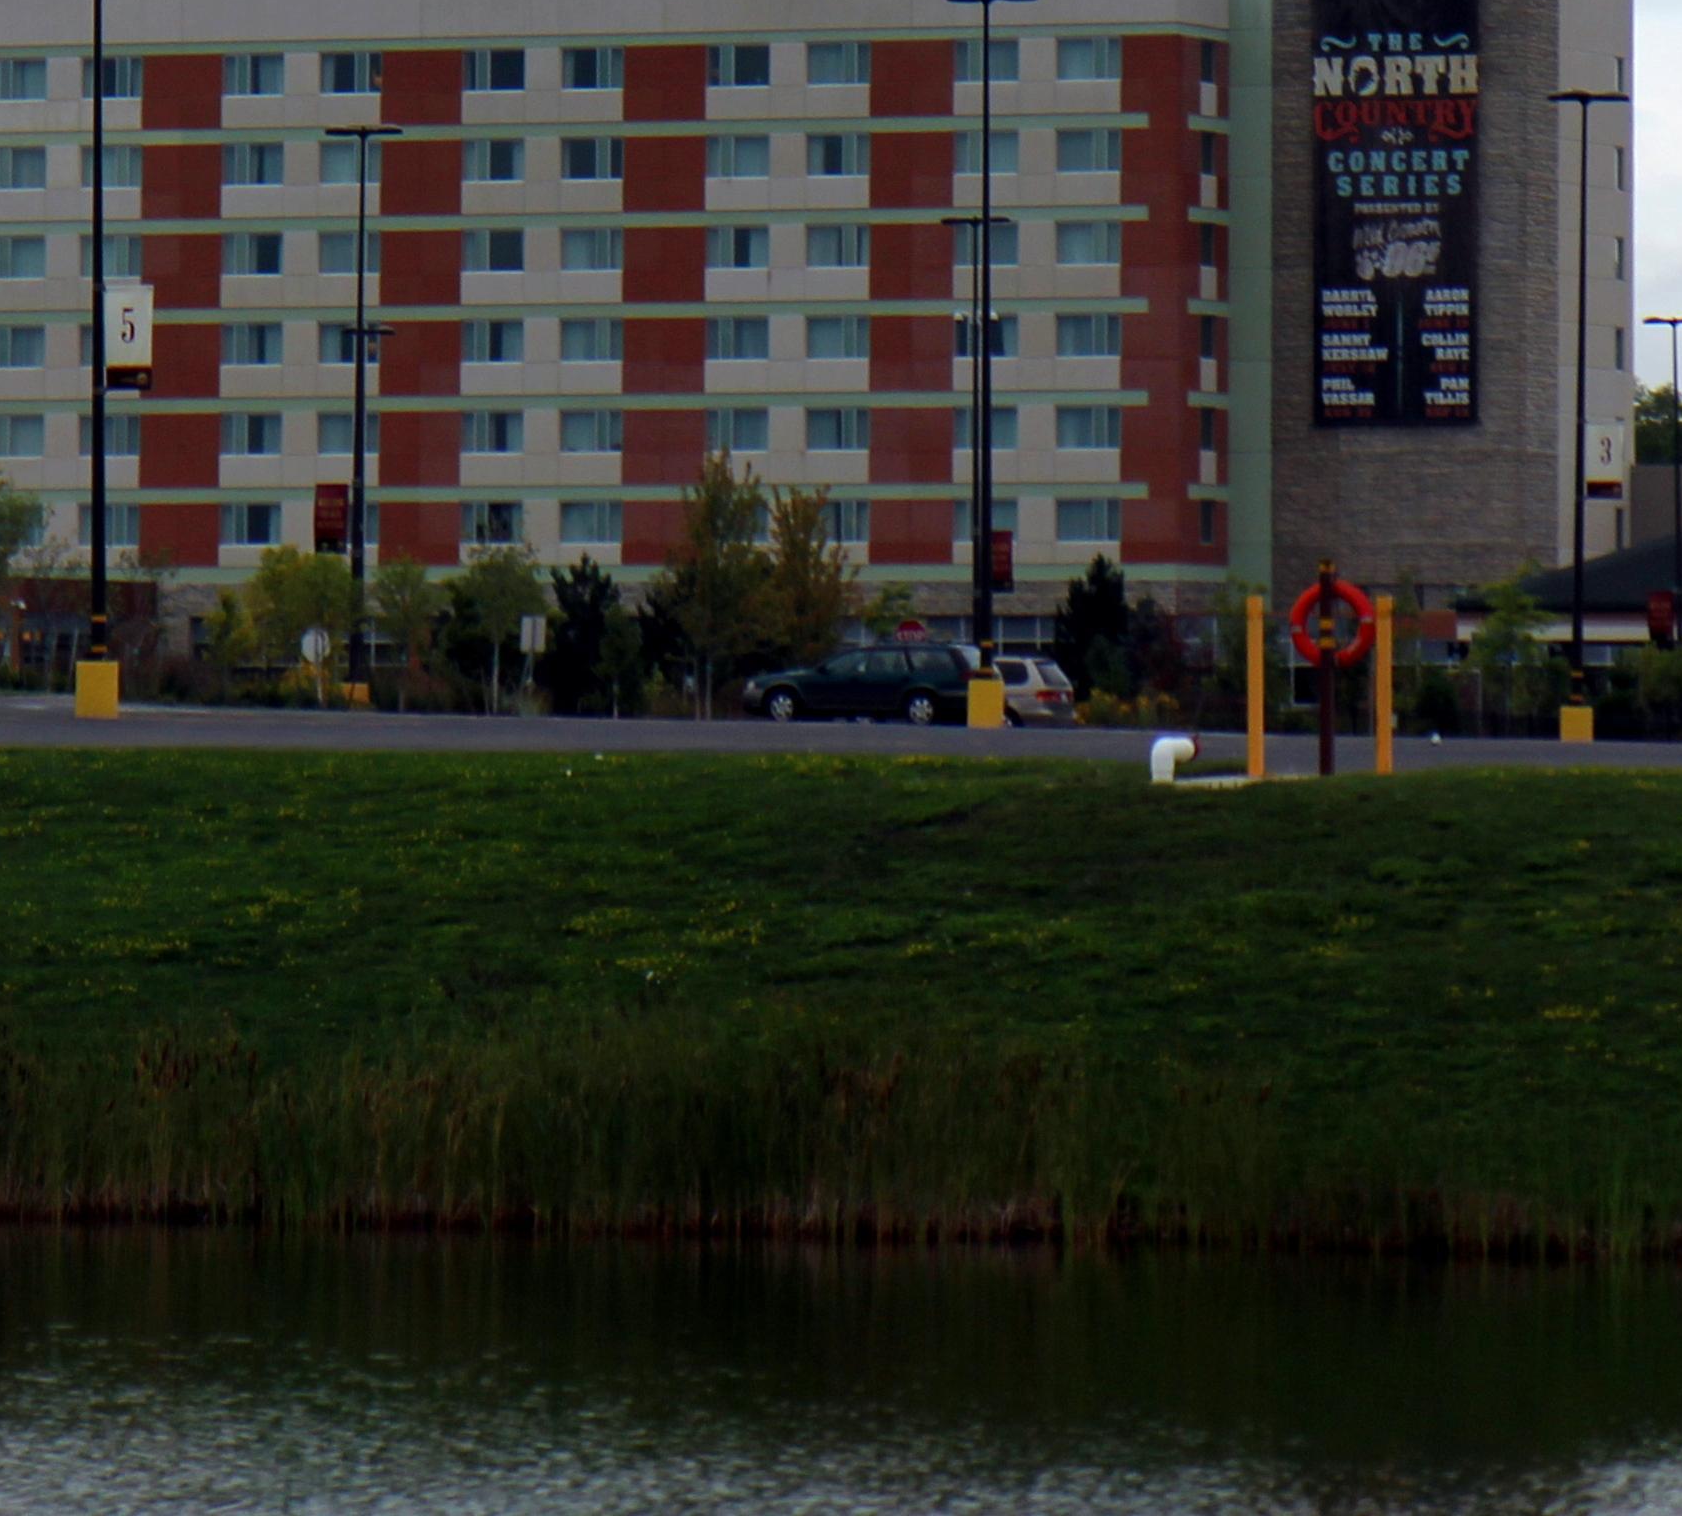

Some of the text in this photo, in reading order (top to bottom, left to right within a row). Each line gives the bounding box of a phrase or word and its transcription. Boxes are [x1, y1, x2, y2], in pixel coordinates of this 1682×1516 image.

[1367, 33, 1423, 51] THE
[1313, 54, 1479, 96] NORTH
[1314, 98, 1479, 143] COUNTRY
[1327, 150, 1470, 172] CONCERT
[1336, 174, 1462, 197] SERIES
[121, 307, 135, 343] 5
[1599, 436, 1612, 466] 3
